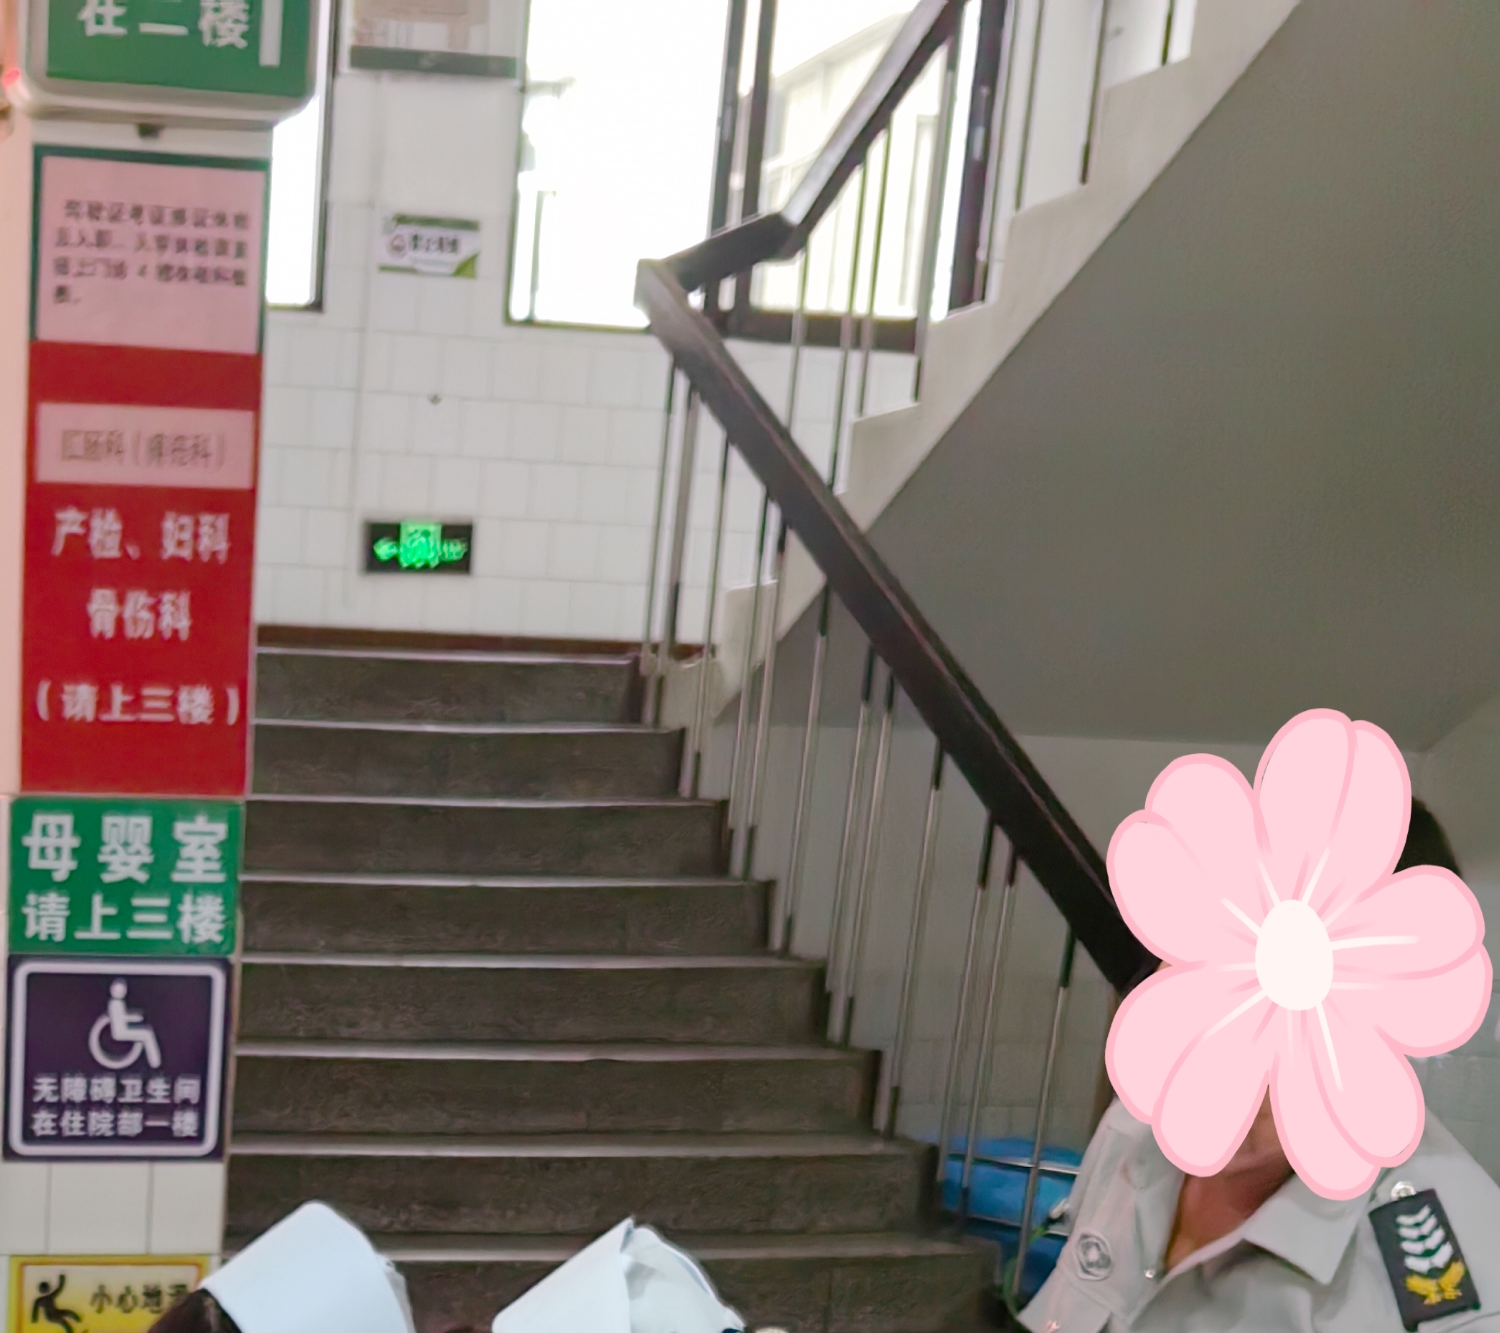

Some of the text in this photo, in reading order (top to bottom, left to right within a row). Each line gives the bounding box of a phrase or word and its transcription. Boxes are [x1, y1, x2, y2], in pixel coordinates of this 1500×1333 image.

[51, 505, 231, 565] 产检、妇科
[87, 586, 192, 641] 骨伤科
[21, 810, 229, 884] 母婴室
[21, 891, 227, 944] 请上三楼
[32, 1074, 201, 1105] 无障碍卫生间
[31, 1109, 199, 1137] 在住院部一楼
